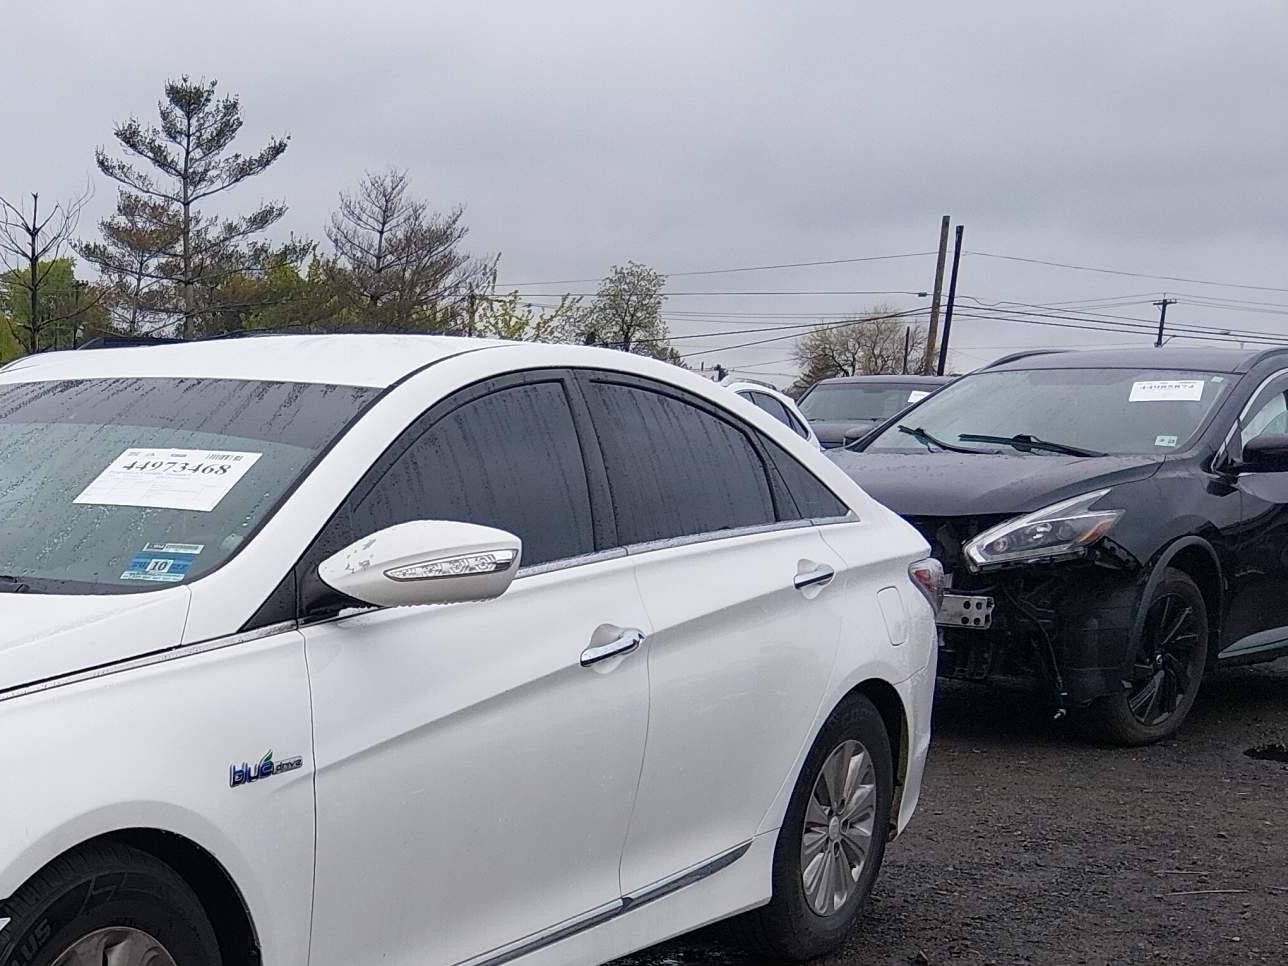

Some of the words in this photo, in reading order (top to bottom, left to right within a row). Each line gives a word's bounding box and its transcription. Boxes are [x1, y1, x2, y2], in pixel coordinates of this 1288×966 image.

[122, 460, 232, 475] 44973468
[149, 560, 169, 571] 10
[229, 752, 275, 788] blue
[276, 758, 303, 774] drive
